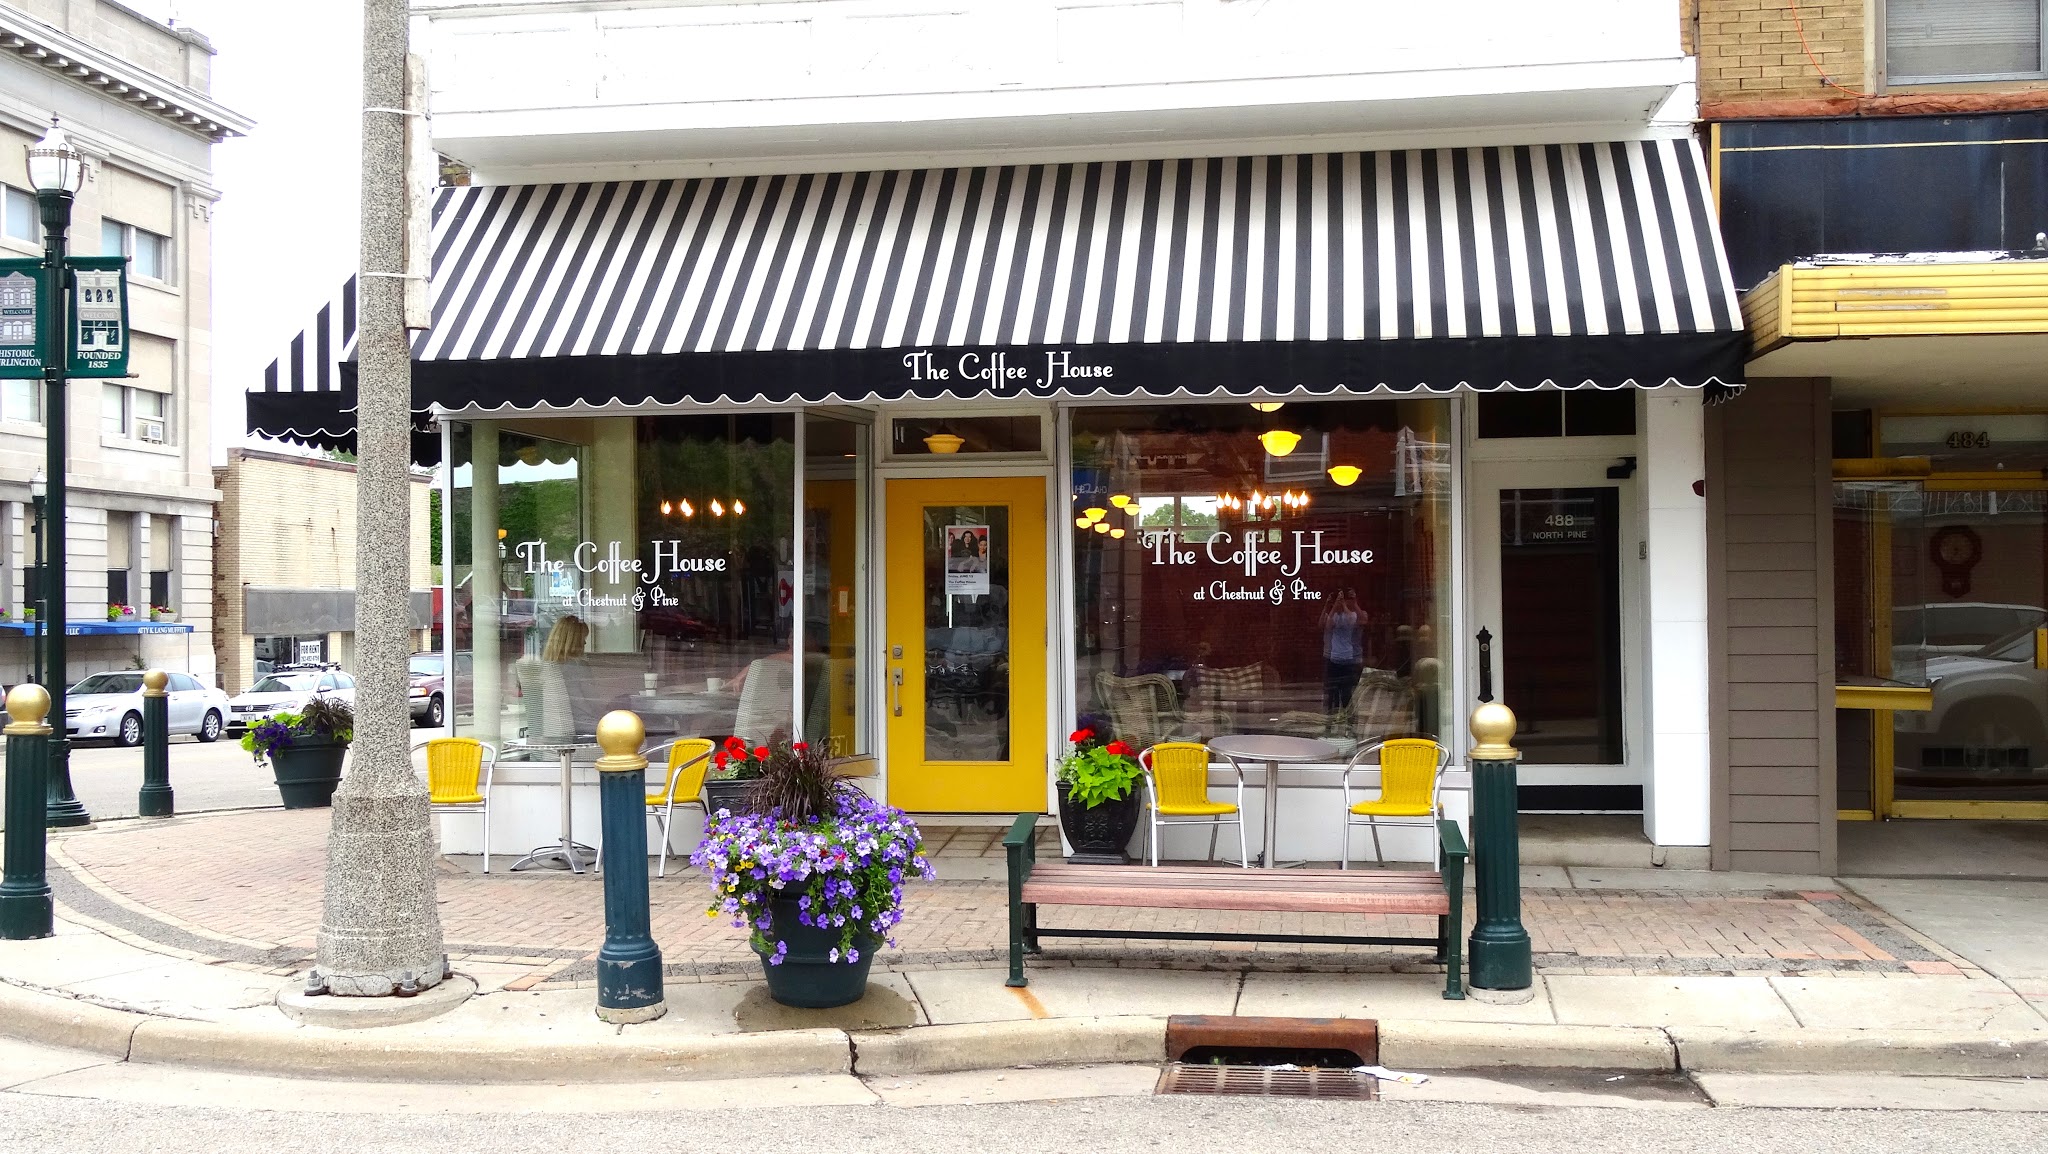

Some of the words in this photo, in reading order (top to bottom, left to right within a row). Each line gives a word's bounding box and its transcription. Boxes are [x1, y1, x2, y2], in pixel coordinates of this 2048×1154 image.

[0, 349, 35, 357] HISTORIC
[77, 351, 121, 360] FOUNDED
[0, 358, 42, 366] RLINGTON
[88, 360, 109, 368] 1835
[903, 349, 950, 380] The
[958, 351, 1028, 389] Coffee
[1036, 351, 1114, 389] House
[1946, 431, 1990, 448] 484
[1544, 514, 1574, 526] 488
[1532, 531, 1564, 540] NORTH
[1567, 530, 1588, 539] PINE
[1142, 528, 1196, 565] The
[1206, 531, 1282, 577] Coffee
[1280, 530, 1374, 577] House
[515, 538, 565, 574] The
[573, 541, 643, 584] Coffee
[641, 540, 726, 584] House
[1193, 587, 1206, 600] at
[1209, 580, 1265, 600] Chestnut
[1269, 579, 1286, 605] &
[1290, 577, 1322, 600] Pine
[563, 594, 573, 606] at
[577, 588, 627, 607] Chestnut
[631, 587, 646, 611] &
[650, 584, 679, 607] Pine
[301, 645, 309, 654] FOR
[309, 644, 320, 654] RENT
